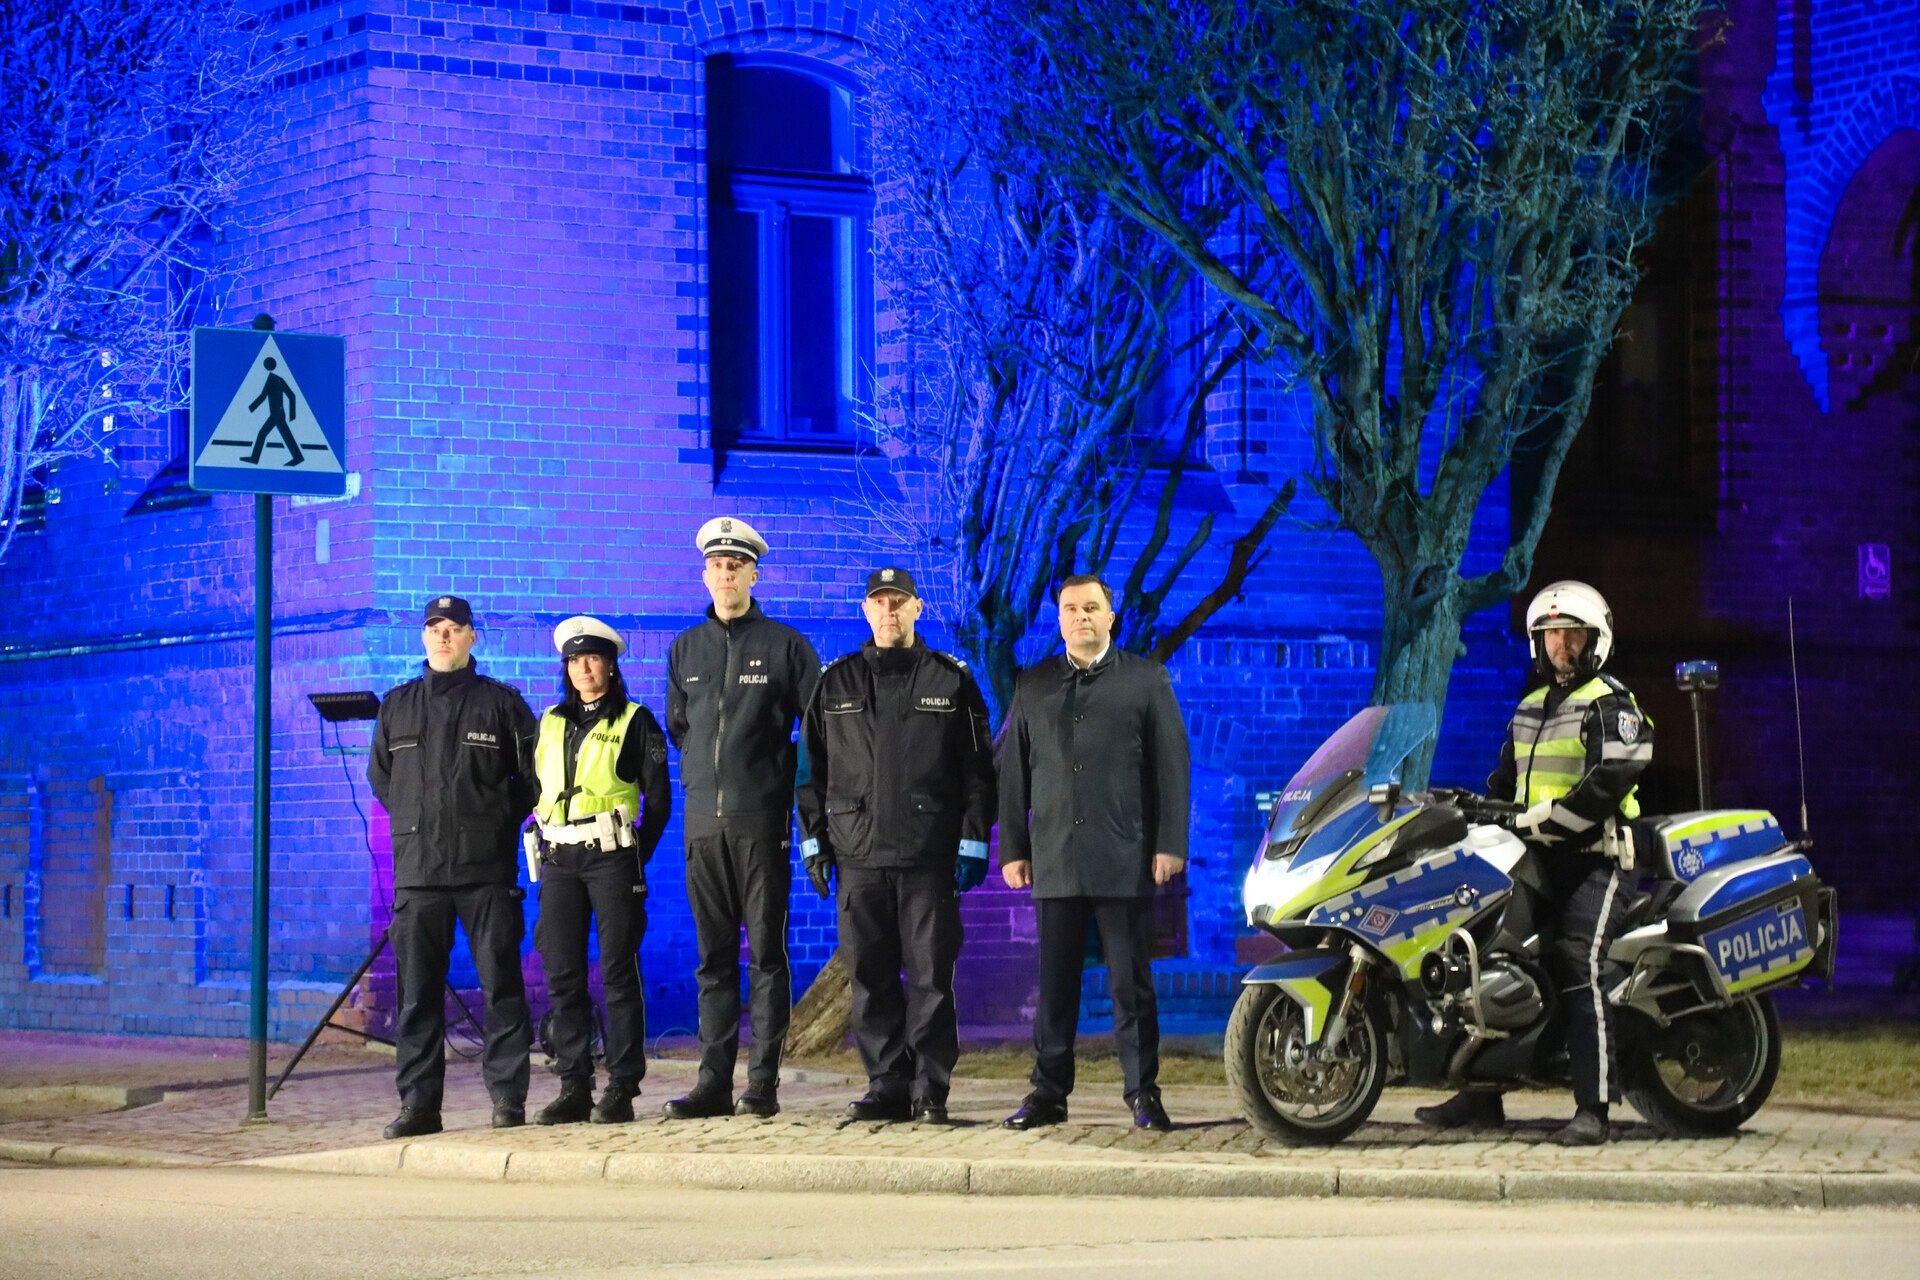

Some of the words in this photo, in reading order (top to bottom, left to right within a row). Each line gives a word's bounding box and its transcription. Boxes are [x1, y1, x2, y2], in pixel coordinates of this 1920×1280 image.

[739, 674, 769, 684] POLICJA
[921, 697, 950, 706] POLICJA
[467, 732, 496, 743] POLICJA
[1718, 914, 1803, 968] POLICJA
